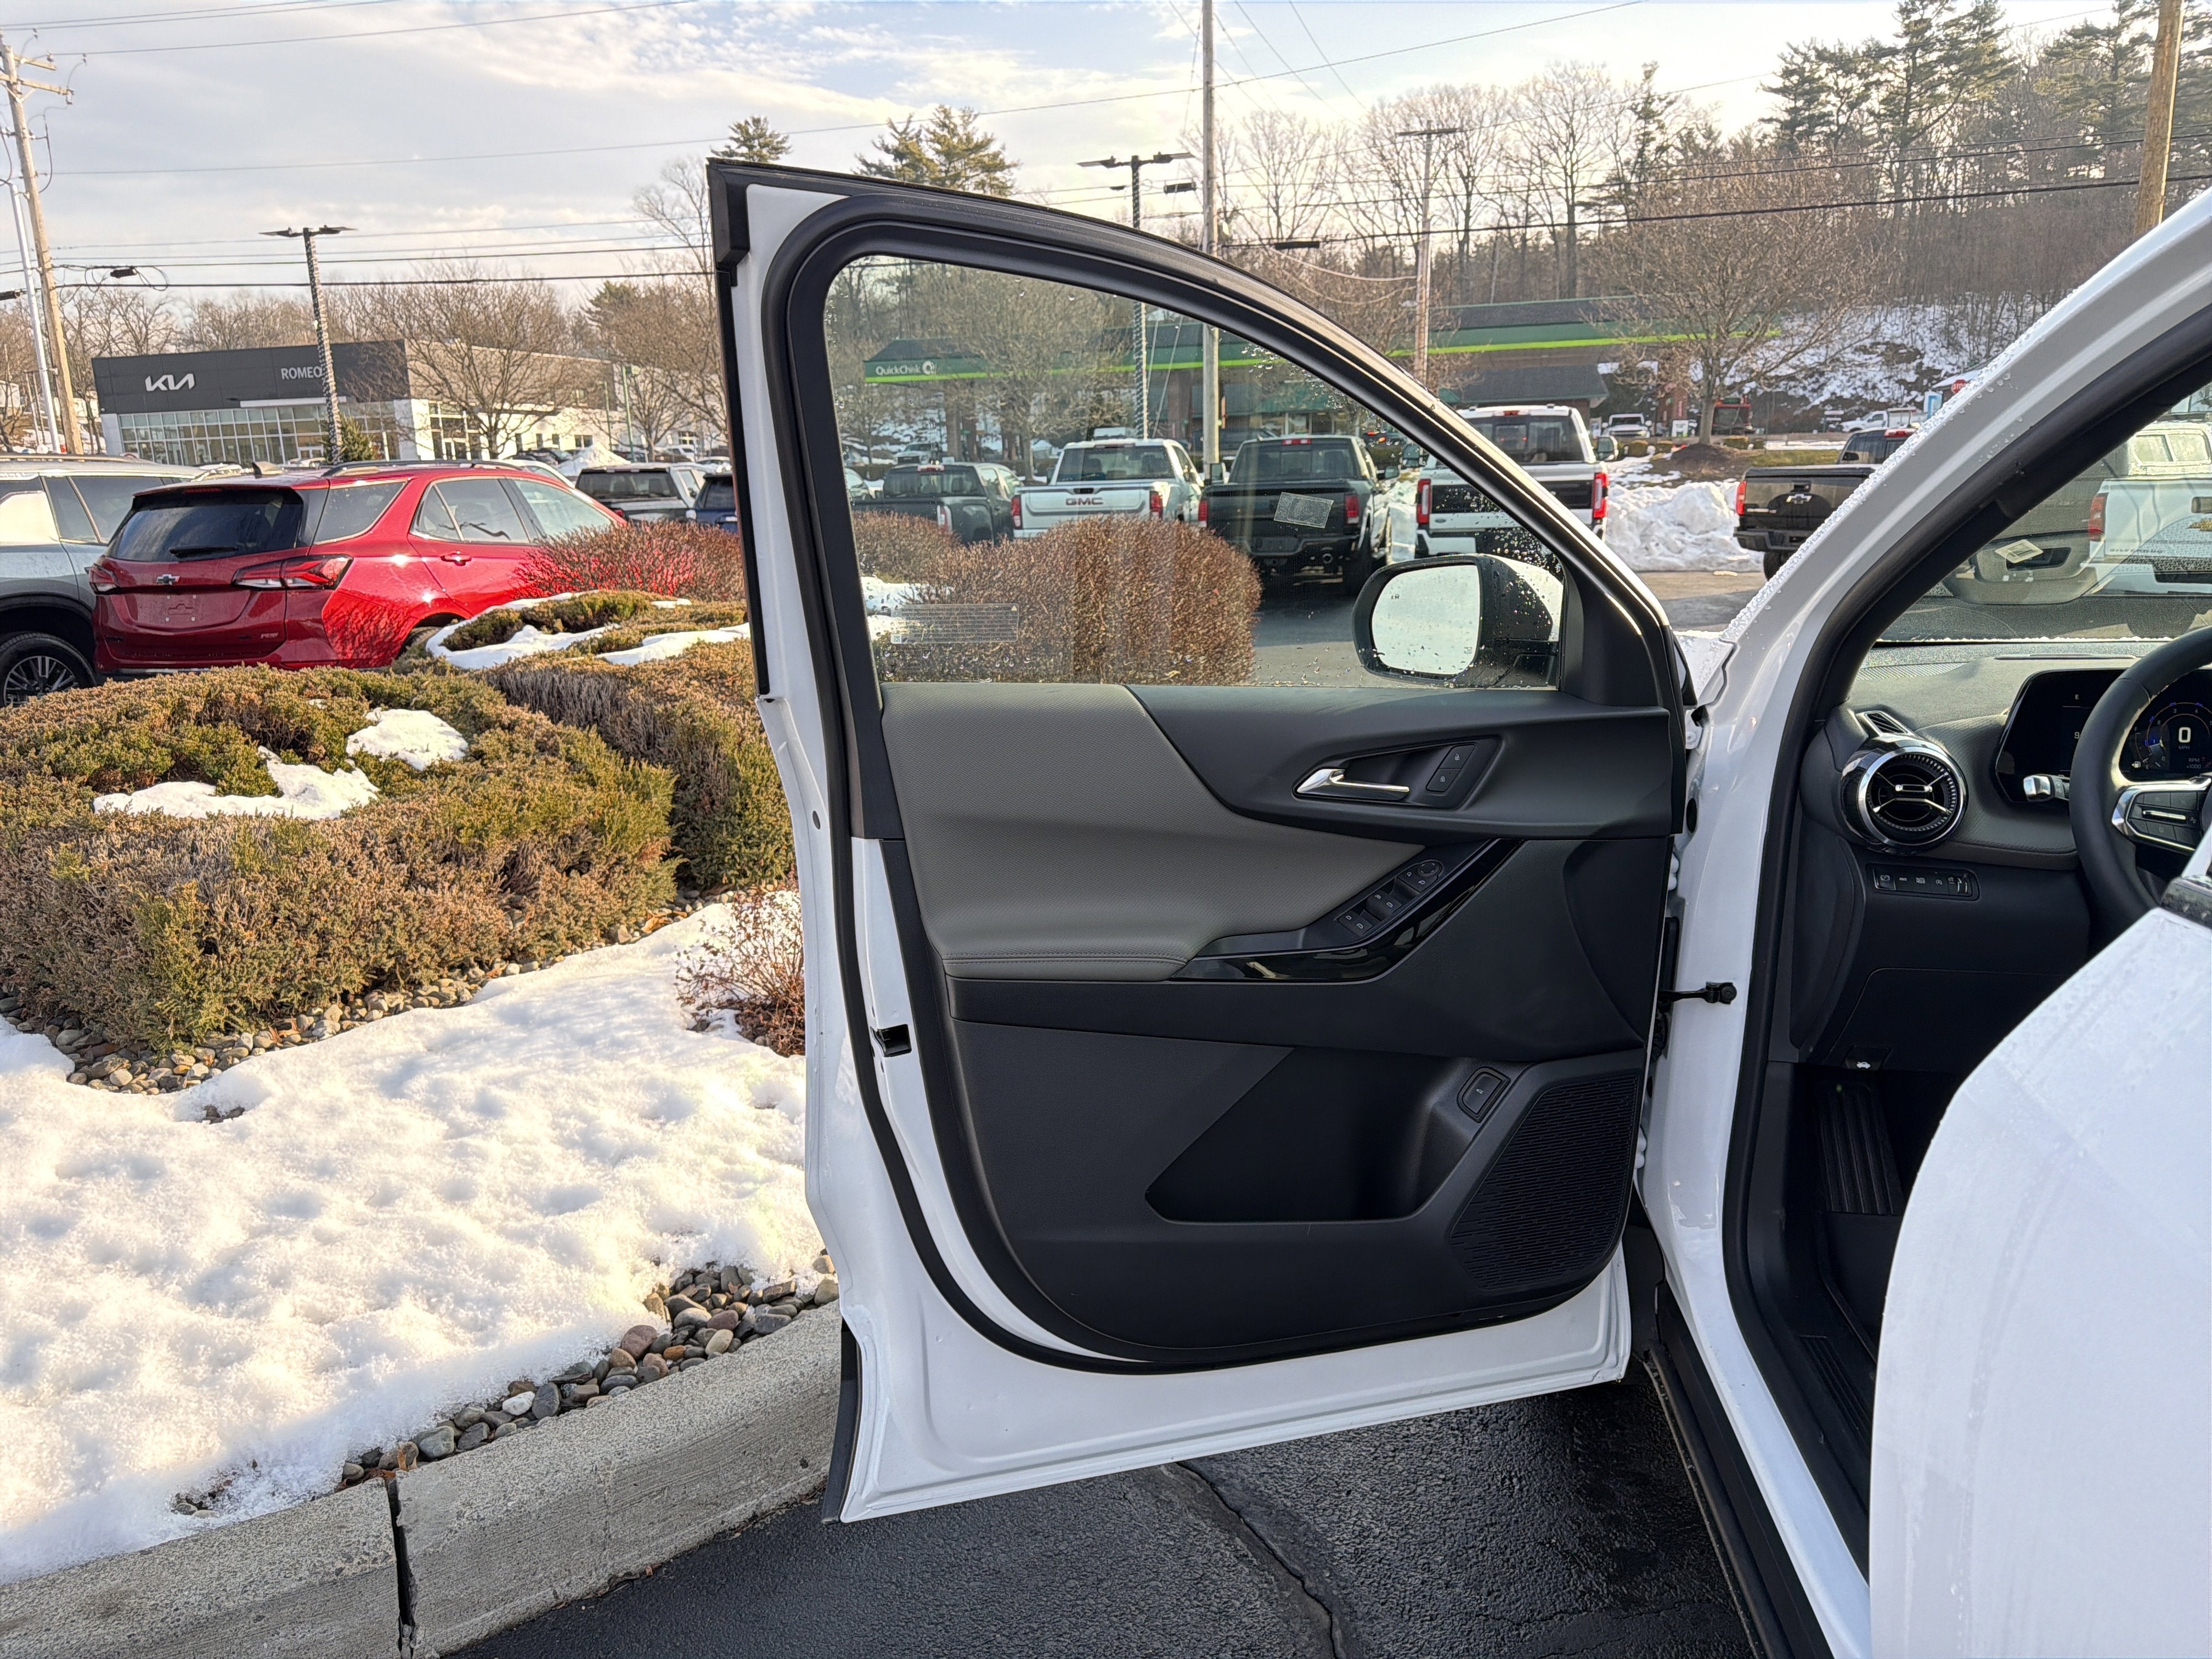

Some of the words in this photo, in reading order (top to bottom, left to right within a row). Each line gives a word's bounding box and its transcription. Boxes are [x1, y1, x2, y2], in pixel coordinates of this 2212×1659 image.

[281, 366, 322, 380] ROMEO
[145, 373, 195, 392] KIA
[1066, 497, 1104, 505] GMC
[2178, 727, 2191, 743] 0
